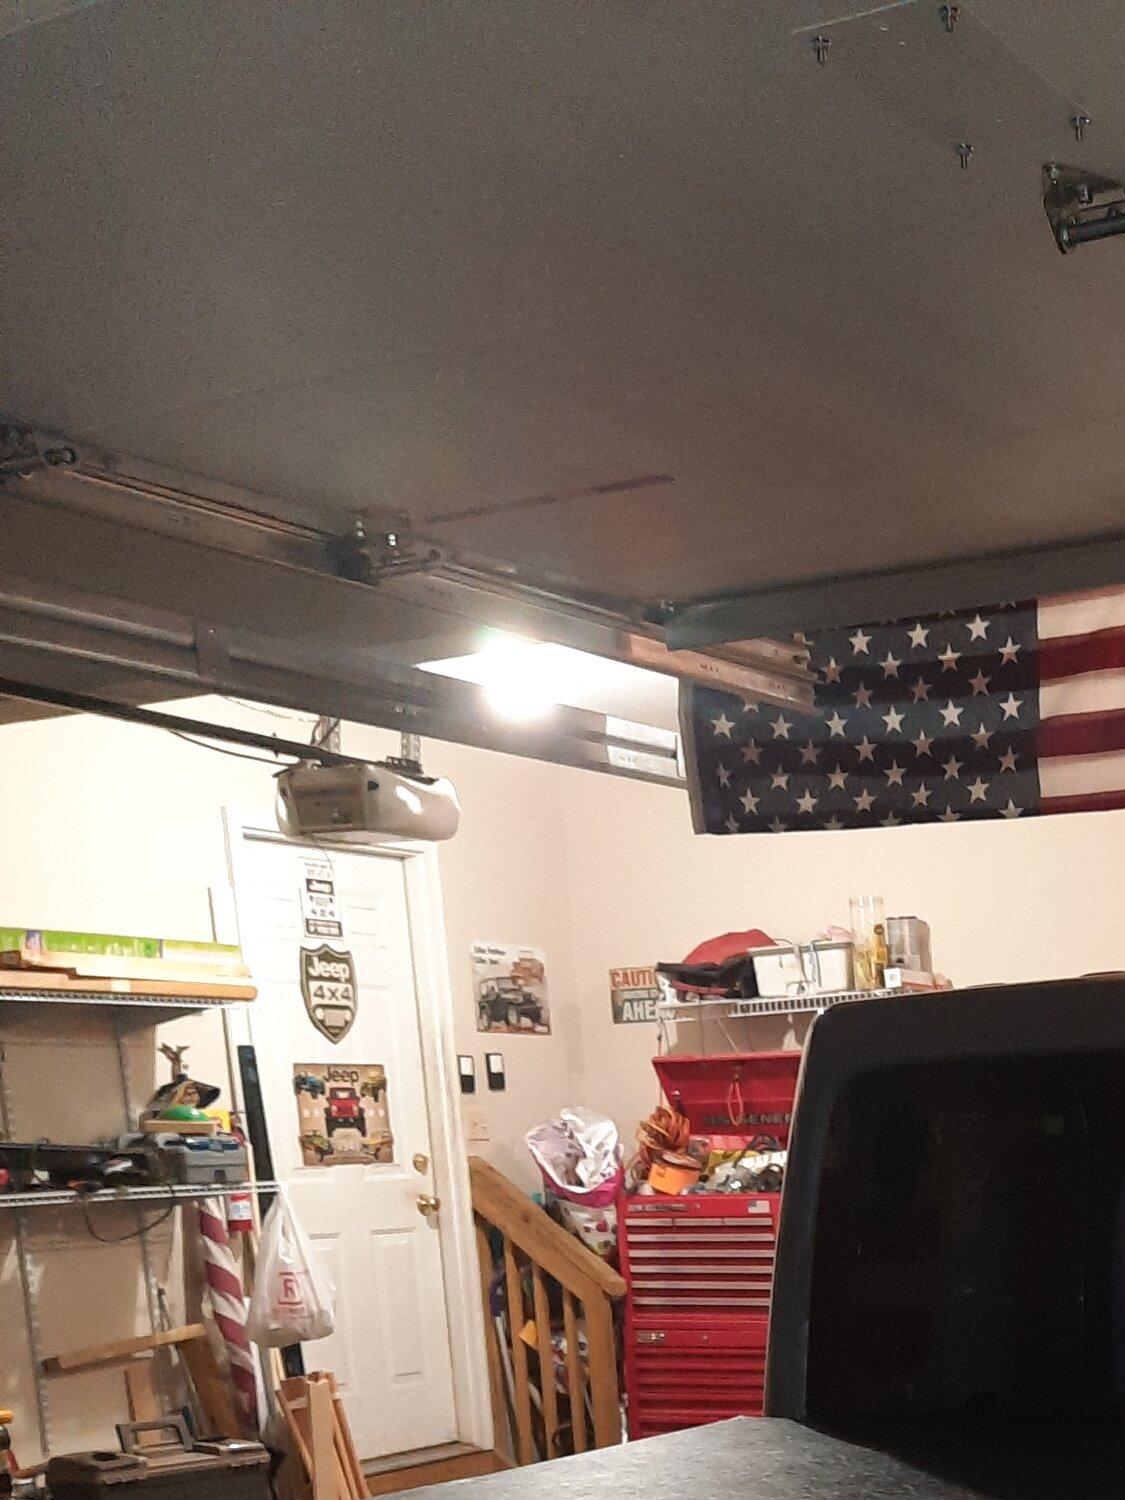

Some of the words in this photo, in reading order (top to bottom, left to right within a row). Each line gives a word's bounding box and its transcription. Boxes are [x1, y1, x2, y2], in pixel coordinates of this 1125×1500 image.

[308, 956, 350, 983] Jeep
[611, 969, 657, 988] CAUTI
[322, 1065, 359, 1085] Jeep
